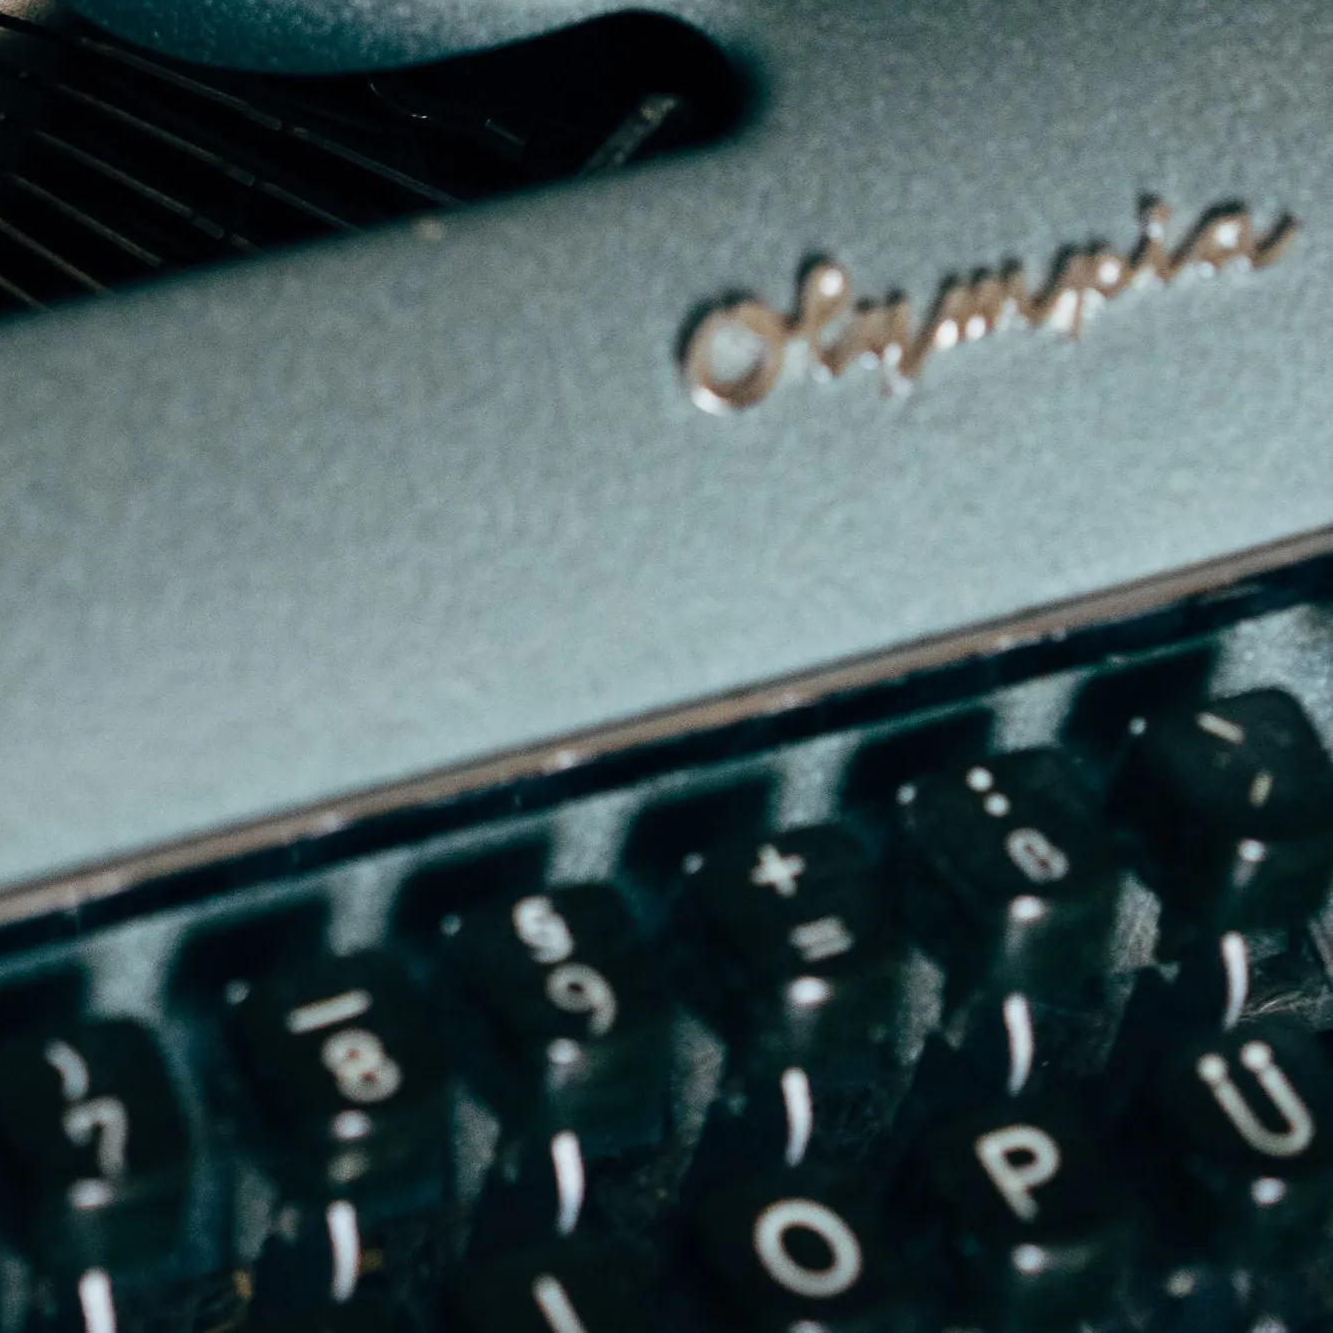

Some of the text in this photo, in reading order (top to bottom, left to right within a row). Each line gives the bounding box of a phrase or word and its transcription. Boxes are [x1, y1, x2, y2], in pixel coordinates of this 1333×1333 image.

[546, 963, 616, 1035] 9
[322, 1029, 401, 1102] 8
[63, 1097, 127, 1177] 7
[975, 1124, 1061, 1220] P
[753, 1197, 863, 1298] O
